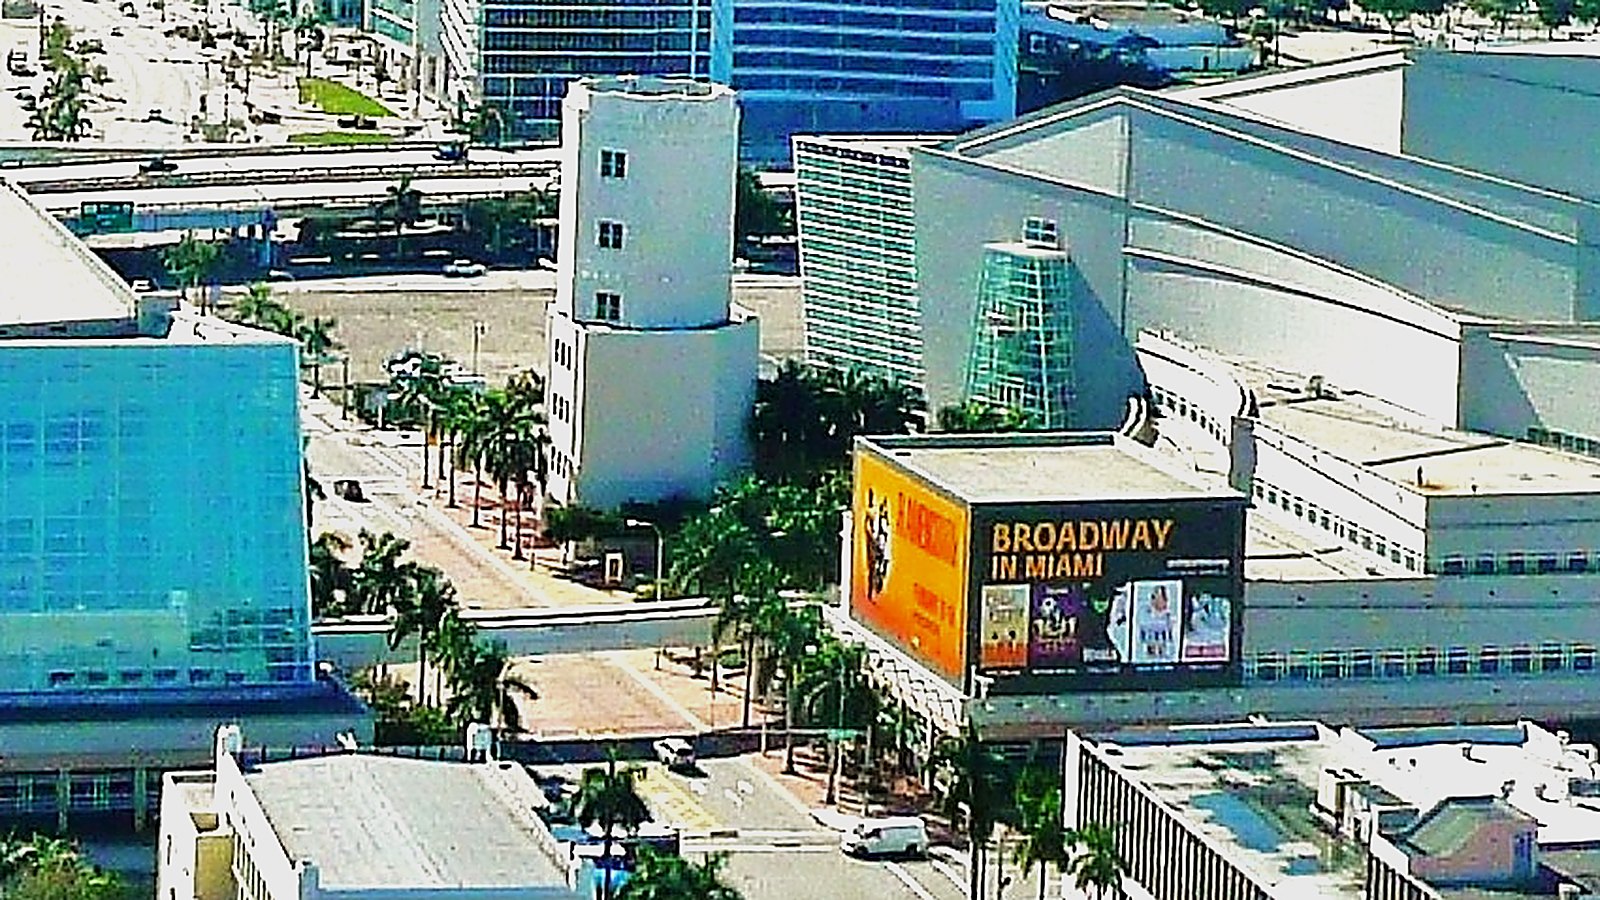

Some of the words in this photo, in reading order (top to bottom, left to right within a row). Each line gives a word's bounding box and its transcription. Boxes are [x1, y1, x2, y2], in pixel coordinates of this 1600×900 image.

[993, 519, 1174, 551] BROADWAY
[992, 555, 1017, 579] IN
[1026, 553, 1102, 578] MIAMI
